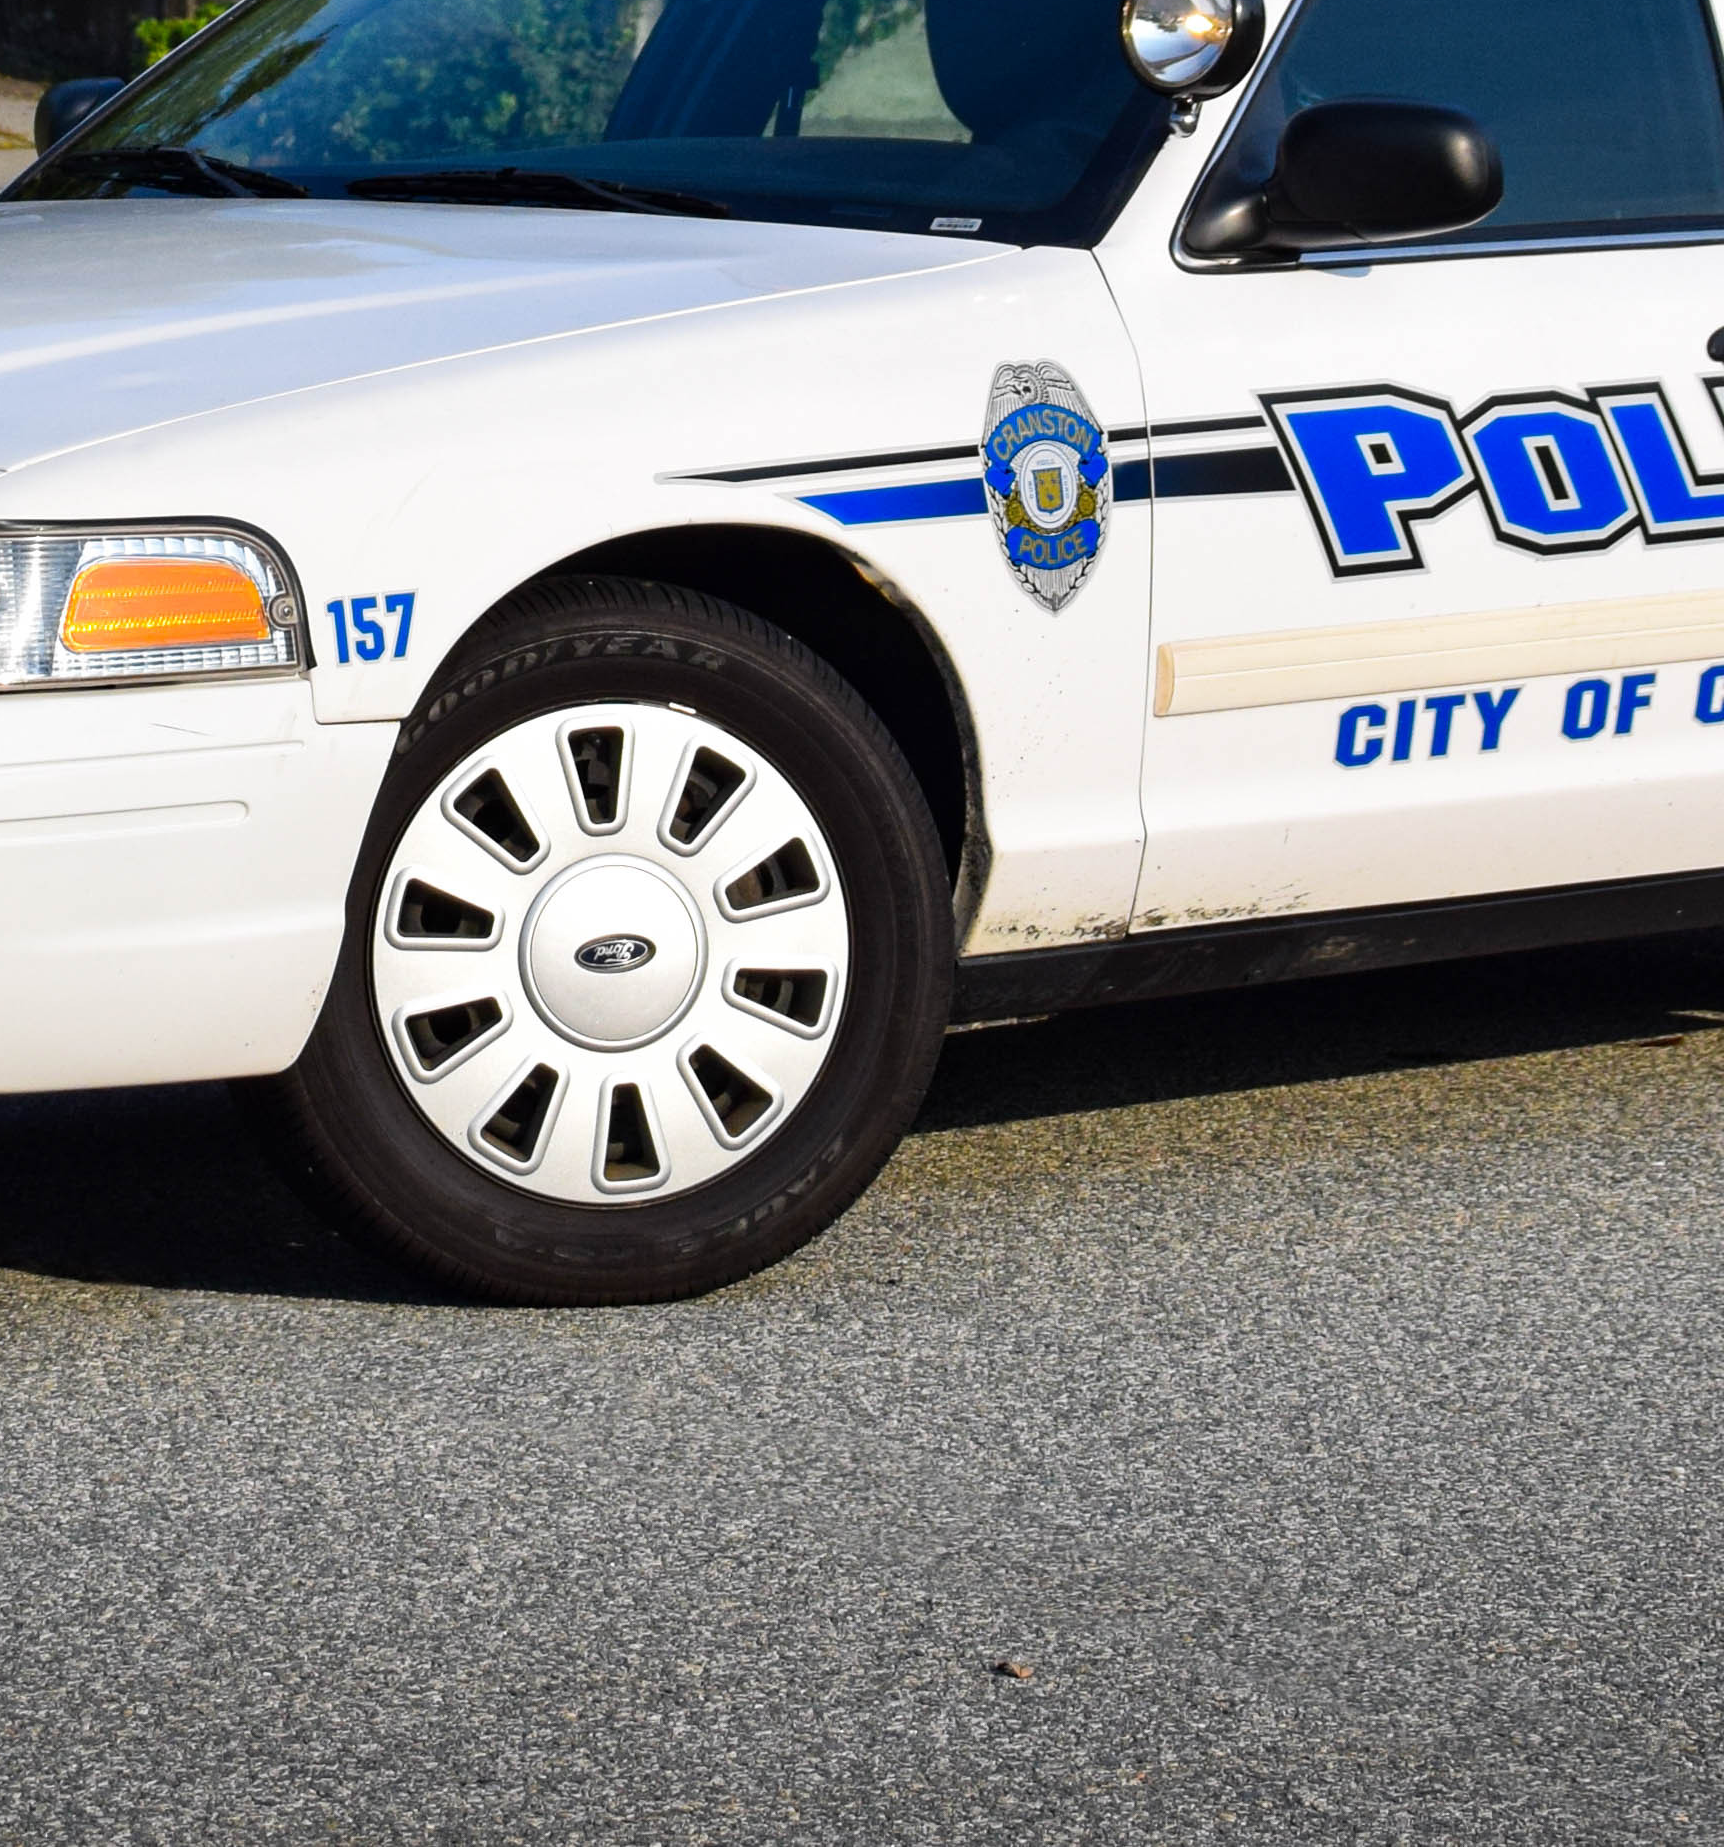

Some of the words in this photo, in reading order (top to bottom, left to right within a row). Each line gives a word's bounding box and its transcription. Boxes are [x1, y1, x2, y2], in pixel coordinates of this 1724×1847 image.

[993, 409, 1093, 459] CRANSTON
[1018, 530, 1087, 564] POLICE
[325, 589, 418, 666] 157
[1334, 687, 1521, 769] CITY
[1561, 673, 1657, 742] OF
